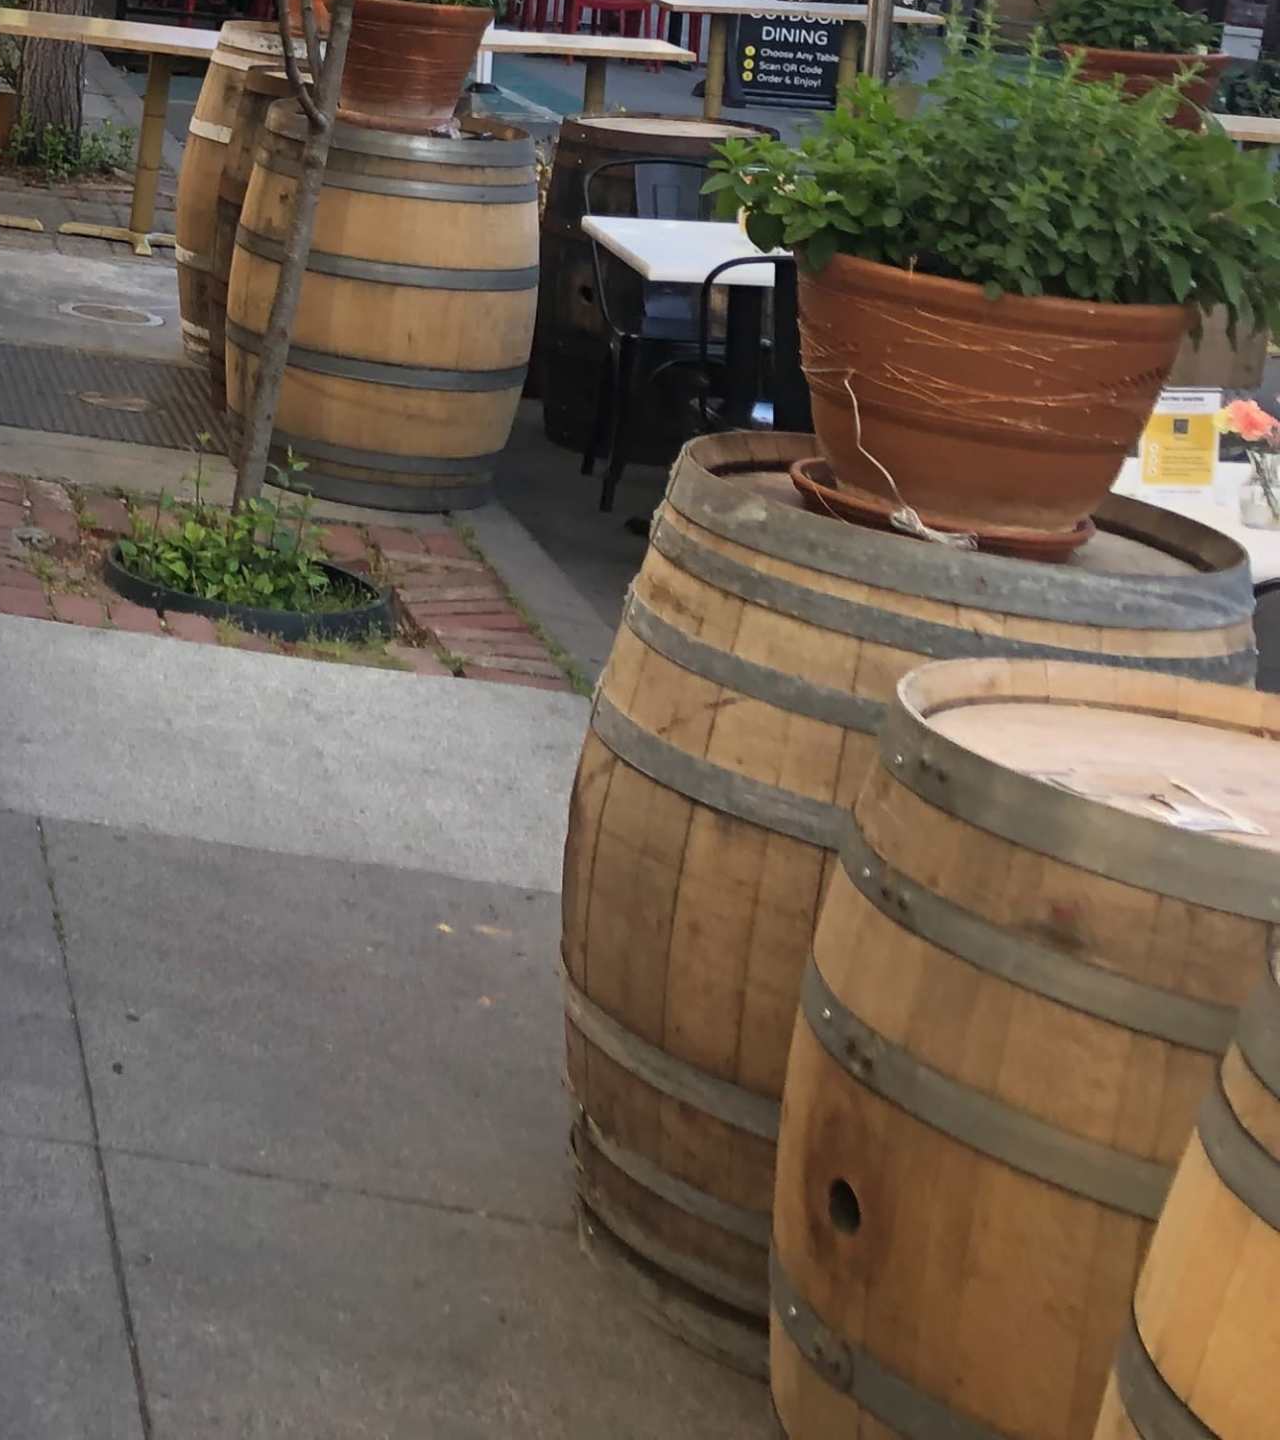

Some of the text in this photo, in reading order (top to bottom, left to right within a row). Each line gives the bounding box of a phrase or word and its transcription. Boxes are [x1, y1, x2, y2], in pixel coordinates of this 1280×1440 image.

[761, 25, 829, 47] DINING
[760, 48, 794, 59] Choose
[795, 51, 814, 62] Any
[815, 52, 841, 63] Table
[759, 61, 781, 71] Scan
[783, 63, 798, 73] QR
[799, 65, 824, 75] Code
[757, 73, 783, 84] Order
[793, 76, 822, 88] Enjoy!
